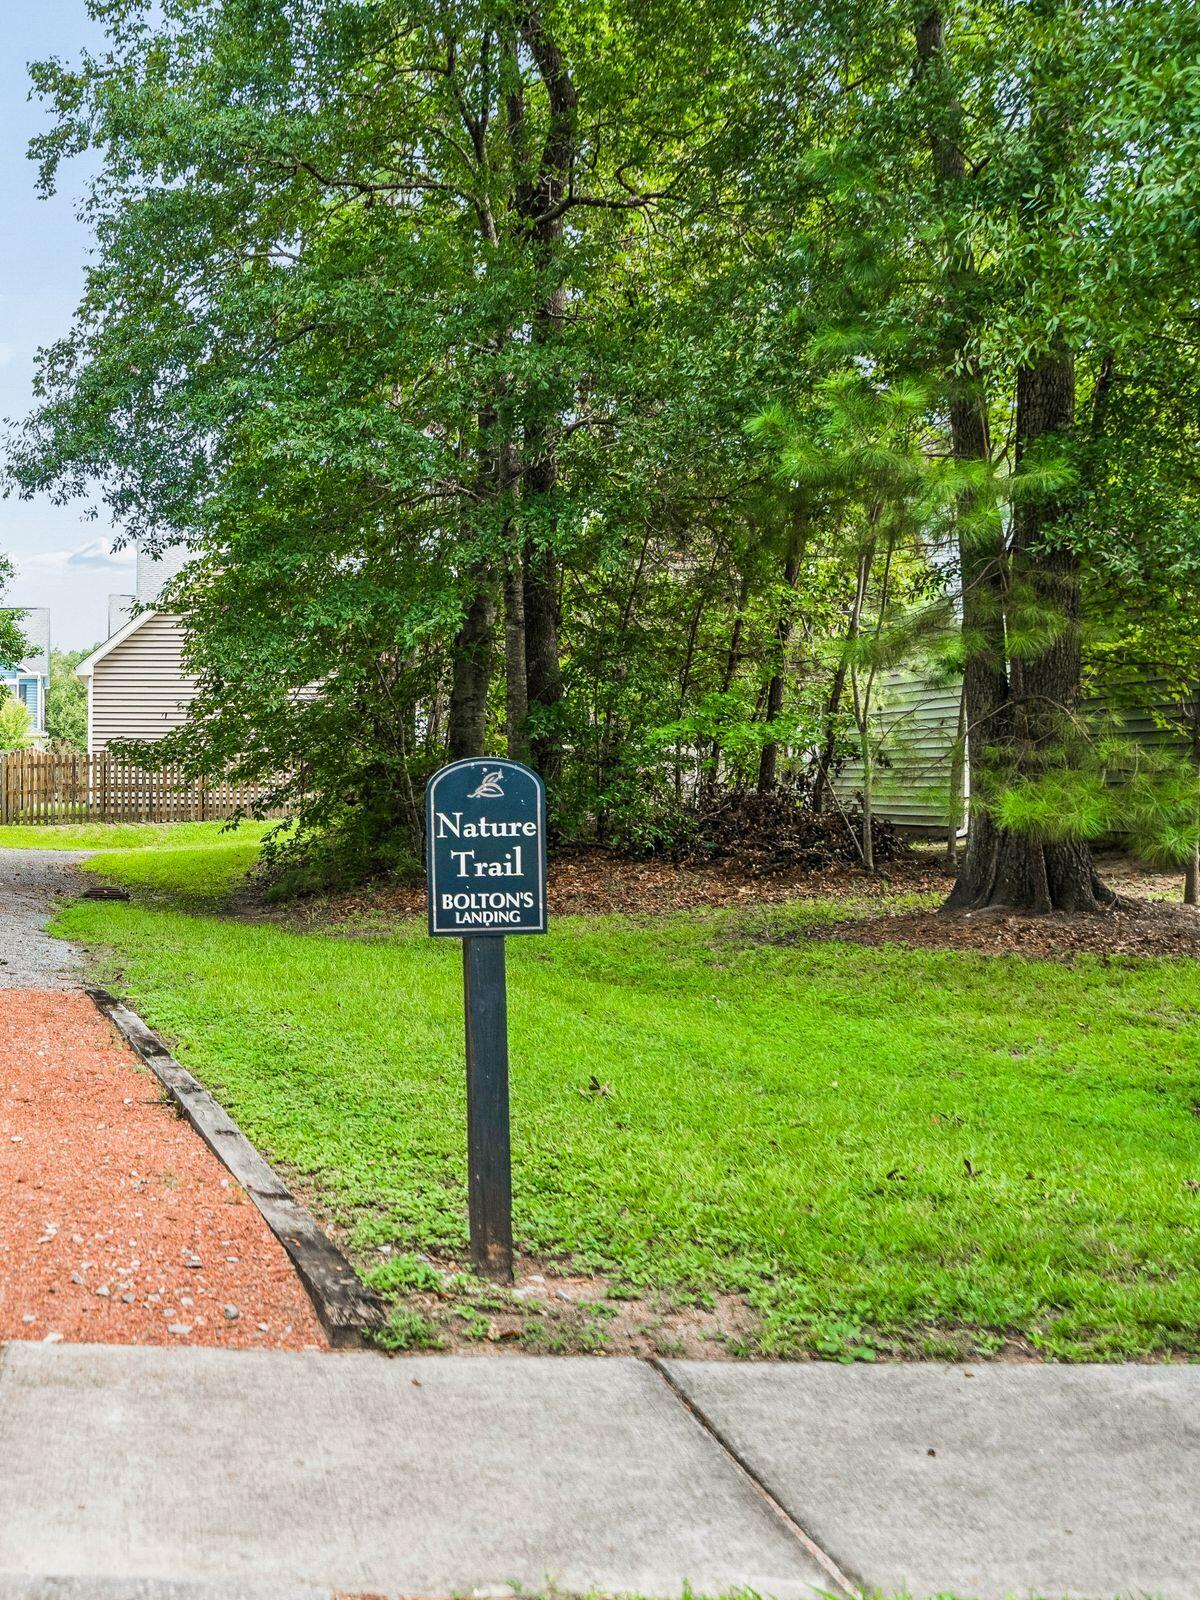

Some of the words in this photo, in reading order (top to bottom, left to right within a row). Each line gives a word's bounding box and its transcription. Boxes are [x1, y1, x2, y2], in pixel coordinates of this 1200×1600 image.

[436, 812, 537, 838] Nature
[450, 846, 524, 877] Trail
[442, 892, 534, 910] BOLTON'S
[455, 910, 521, 924] LANDING
